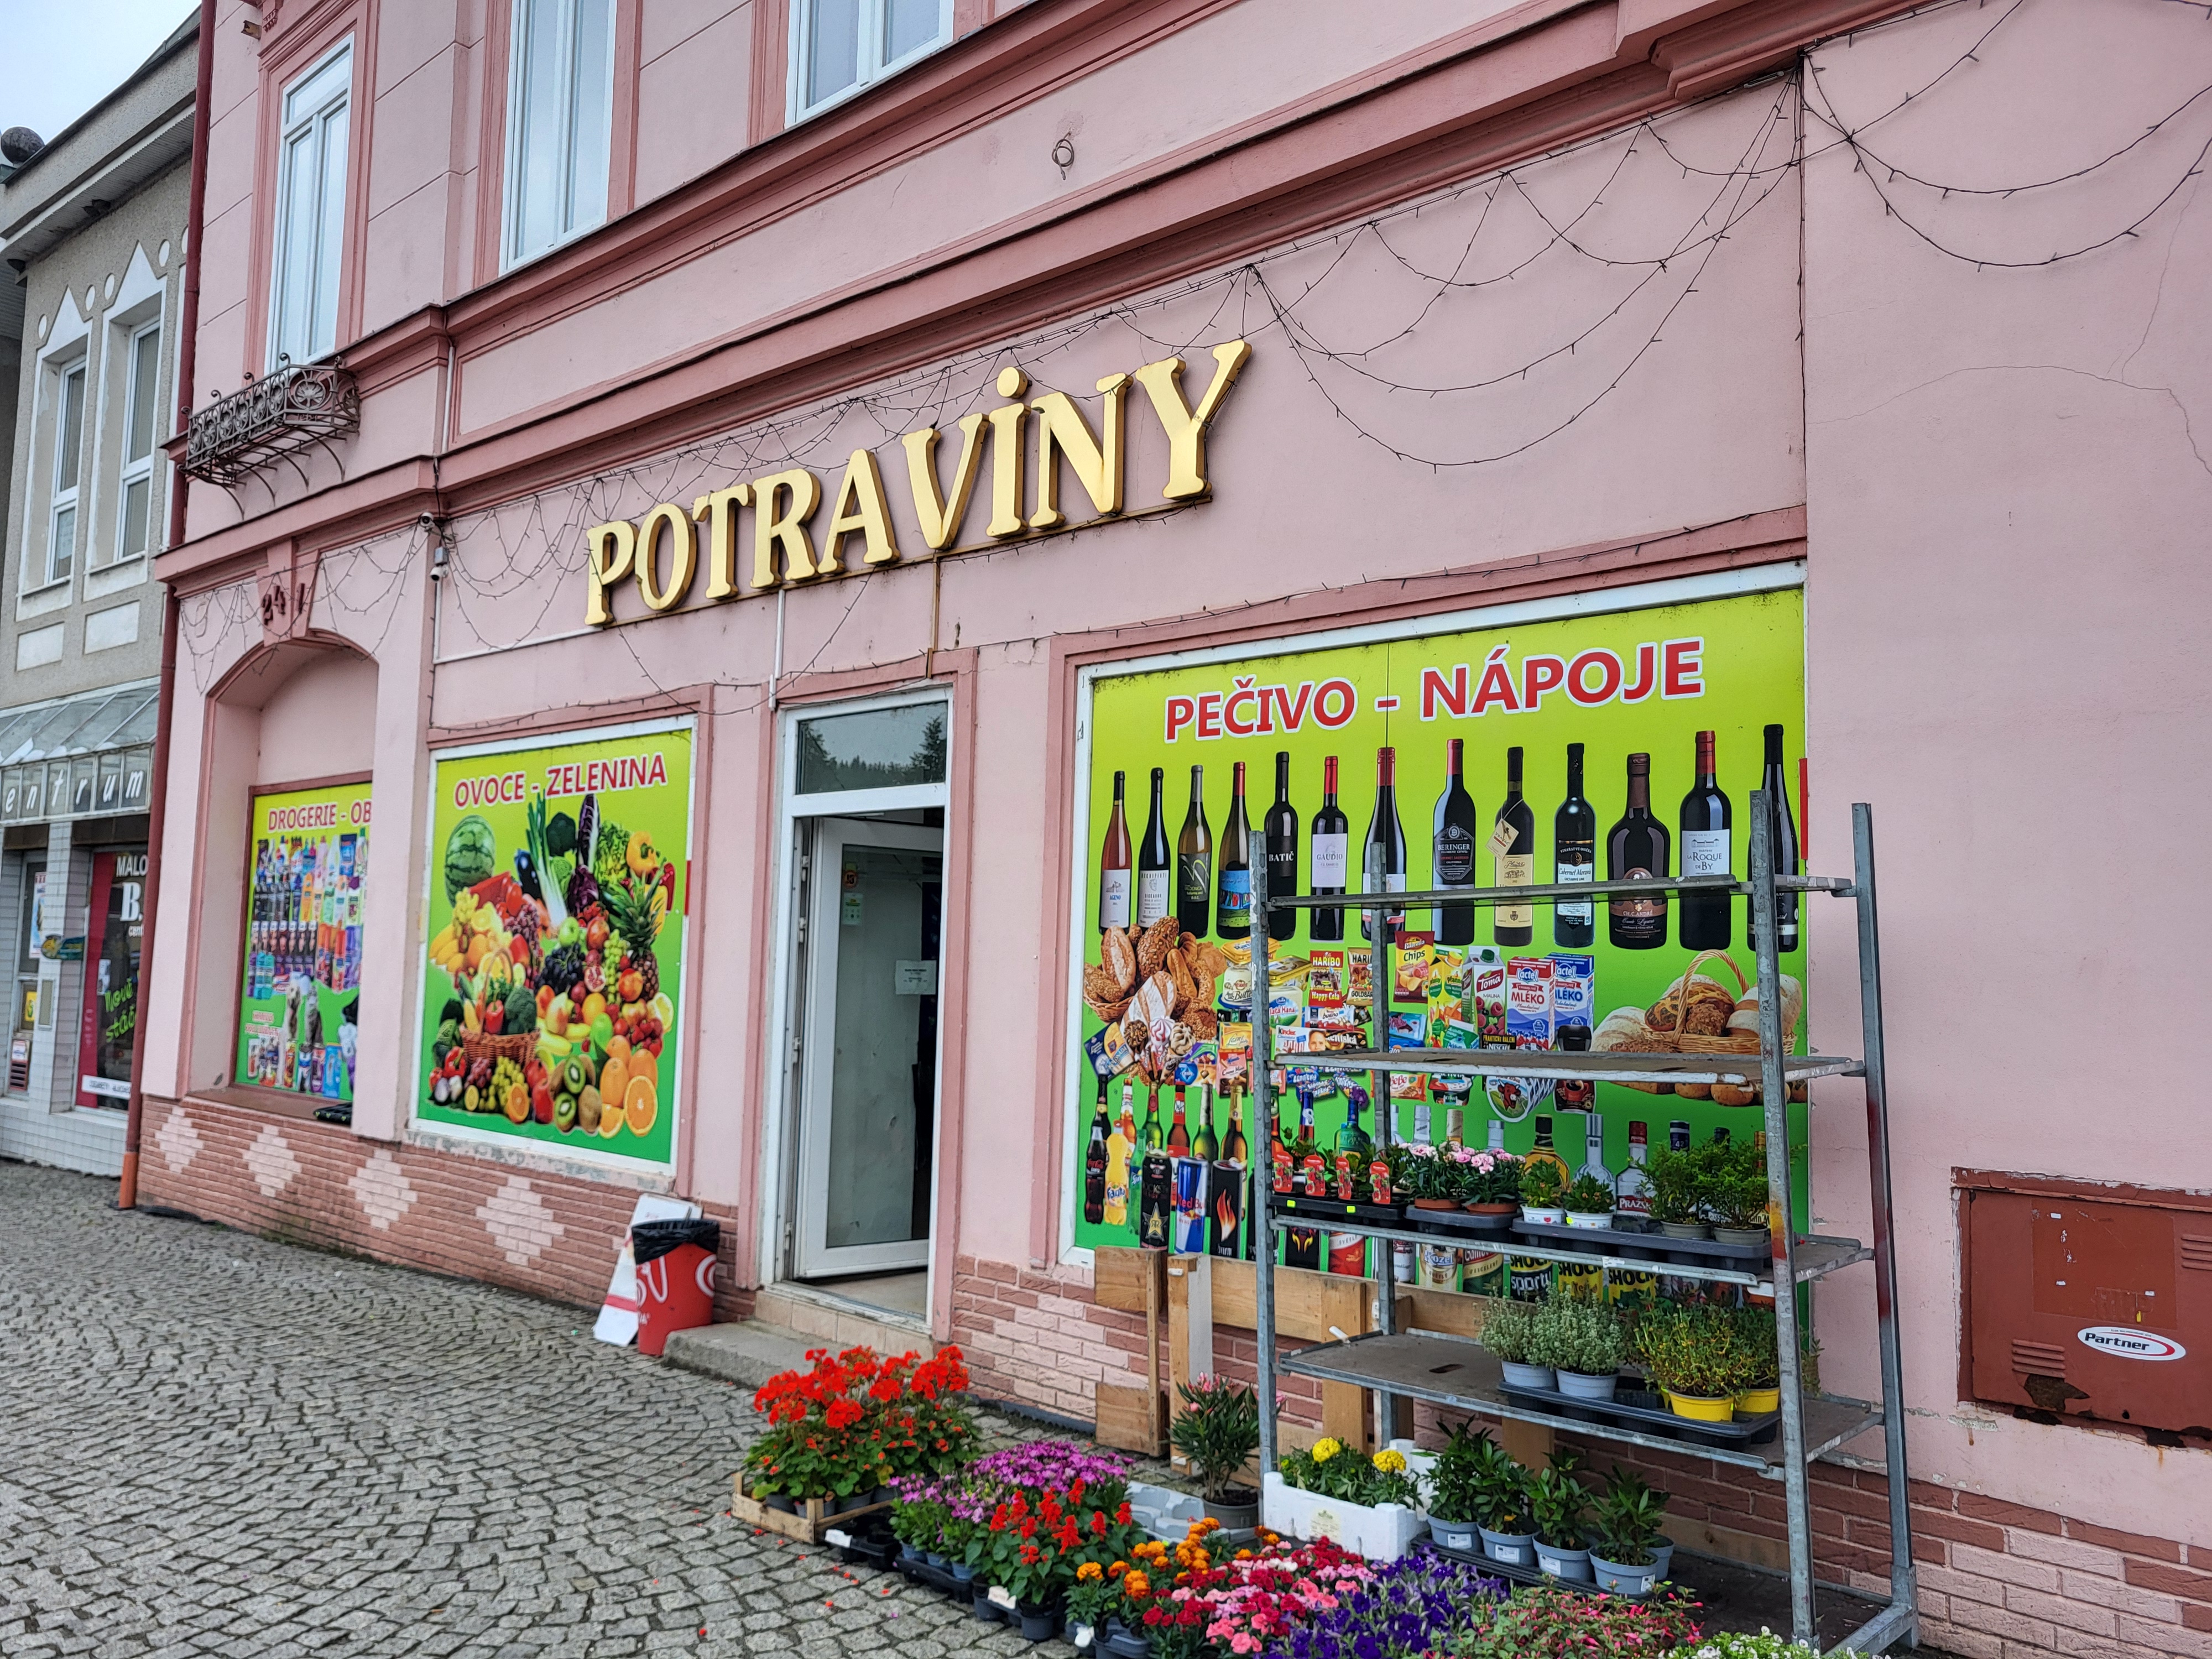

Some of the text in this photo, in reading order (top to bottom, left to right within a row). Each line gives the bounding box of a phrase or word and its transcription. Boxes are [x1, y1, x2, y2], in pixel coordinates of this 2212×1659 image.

[1166, 677, 1355, 741] PEČIVO
[1422, 646, 1702, 720] NÁPOJE
[454, 773, 525, 807] OVOCE
[546, 753, 667, 797] ZELENINA
[269, 804, 336, 830] DROGERIE
[1269, 851, 1295, 862] BATIČ
[1692, 852, 1722, 862] ROQUE
[1312, 957, 1340, 967] HARIBO
[1404, 950, 1426, 962] Chips
[1478, 973, 1501, 991] Toma
[1517, 968, 1539, 982] lactel
[1311, 992, 1339, 1001] Happy Cola
[1511, 990, 1545, 1004] MLÉKO
[1322, 1011, 1339, 1019] bueno
[1177, 1195, 1193, 1208] Red
[1425, 1250, 1453, 1265] Kozel
[1511, 1271, 1552, 1297] sporty
[2084, 1332, 2150, 1350] Partner
